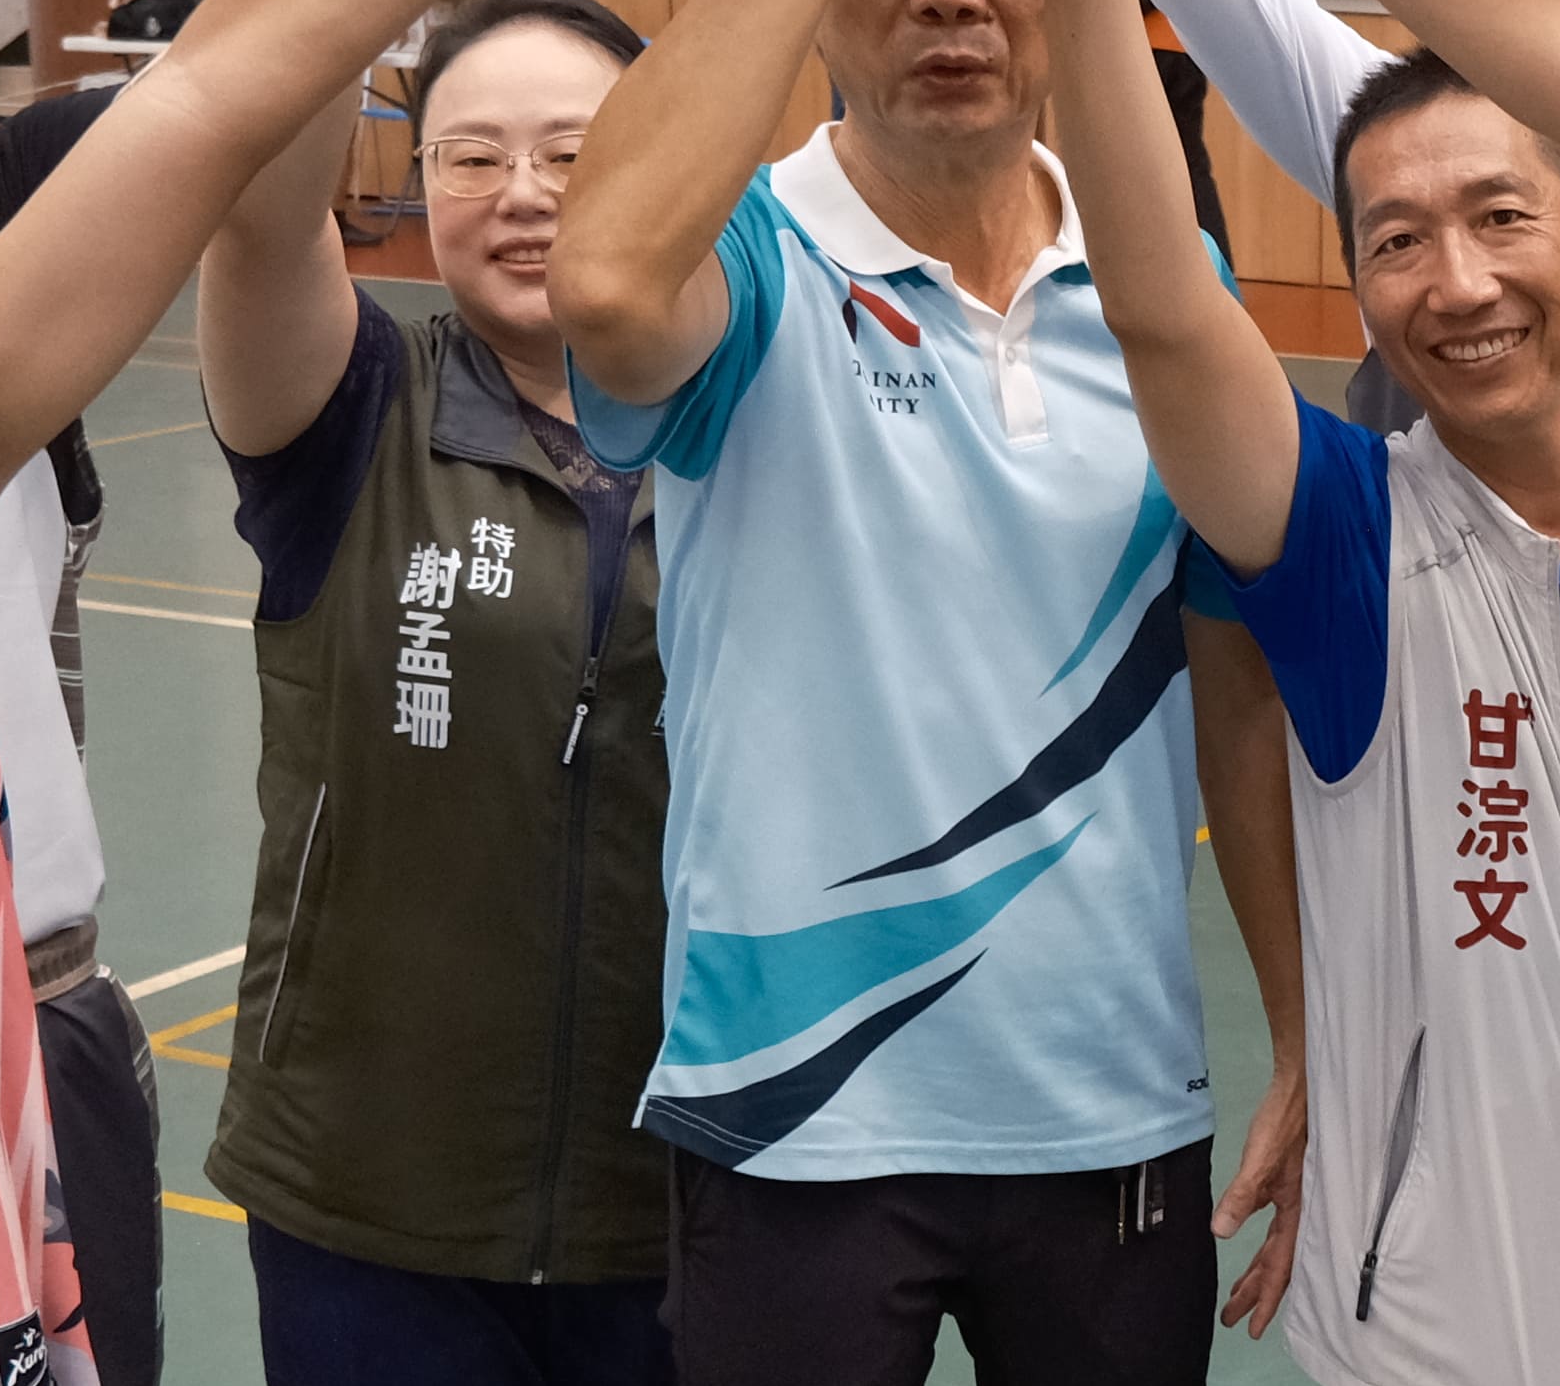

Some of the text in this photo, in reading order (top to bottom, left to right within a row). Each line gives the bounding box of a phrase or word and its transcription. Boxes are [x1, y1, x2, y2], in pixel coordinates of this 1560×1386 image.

[852, 359, 936, 389] TINAN
[869, 393, 920, 414] ITY
[466, 516, 516, 599] 特助
[392, 541, 462, 750] 謝孟珊
[1453, 688, 1529, 951] 甘淙文
